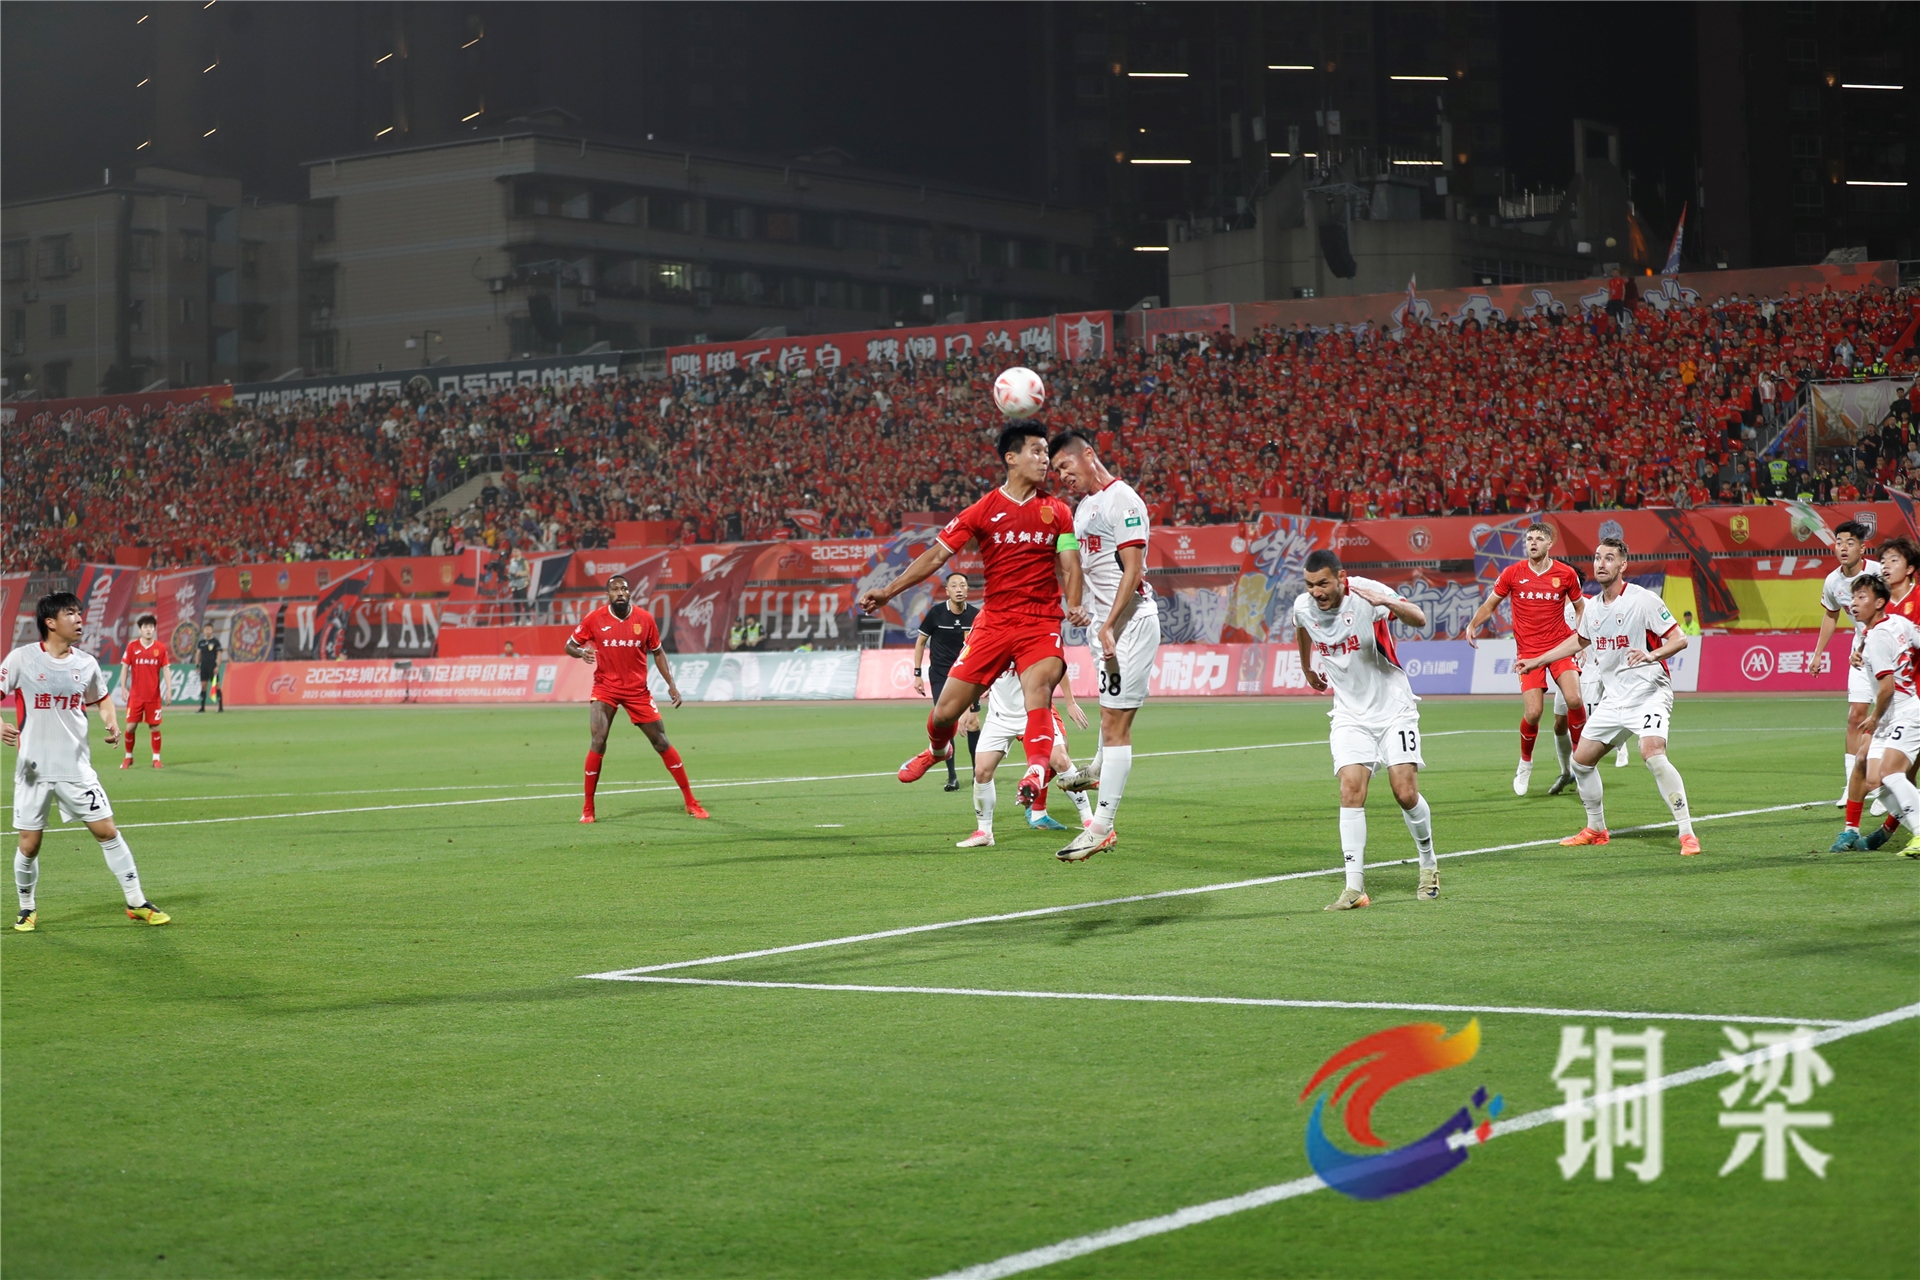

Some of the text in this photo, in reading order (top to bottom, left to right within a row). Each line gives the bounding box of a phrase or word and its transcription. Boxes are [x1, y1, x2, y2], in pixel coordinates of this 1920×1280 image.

[811, 545, 883, 560] 2025华润
[1050, 632, 1061, 648] 7
[1150, 651, 1230, 691] 耐力
[1099, 672, 1121, 696] 38
[1643, 713, 1662, 728] 27
[1398, 730, 1416, 752] 13
[1887, 725, 1905, 741] 5
